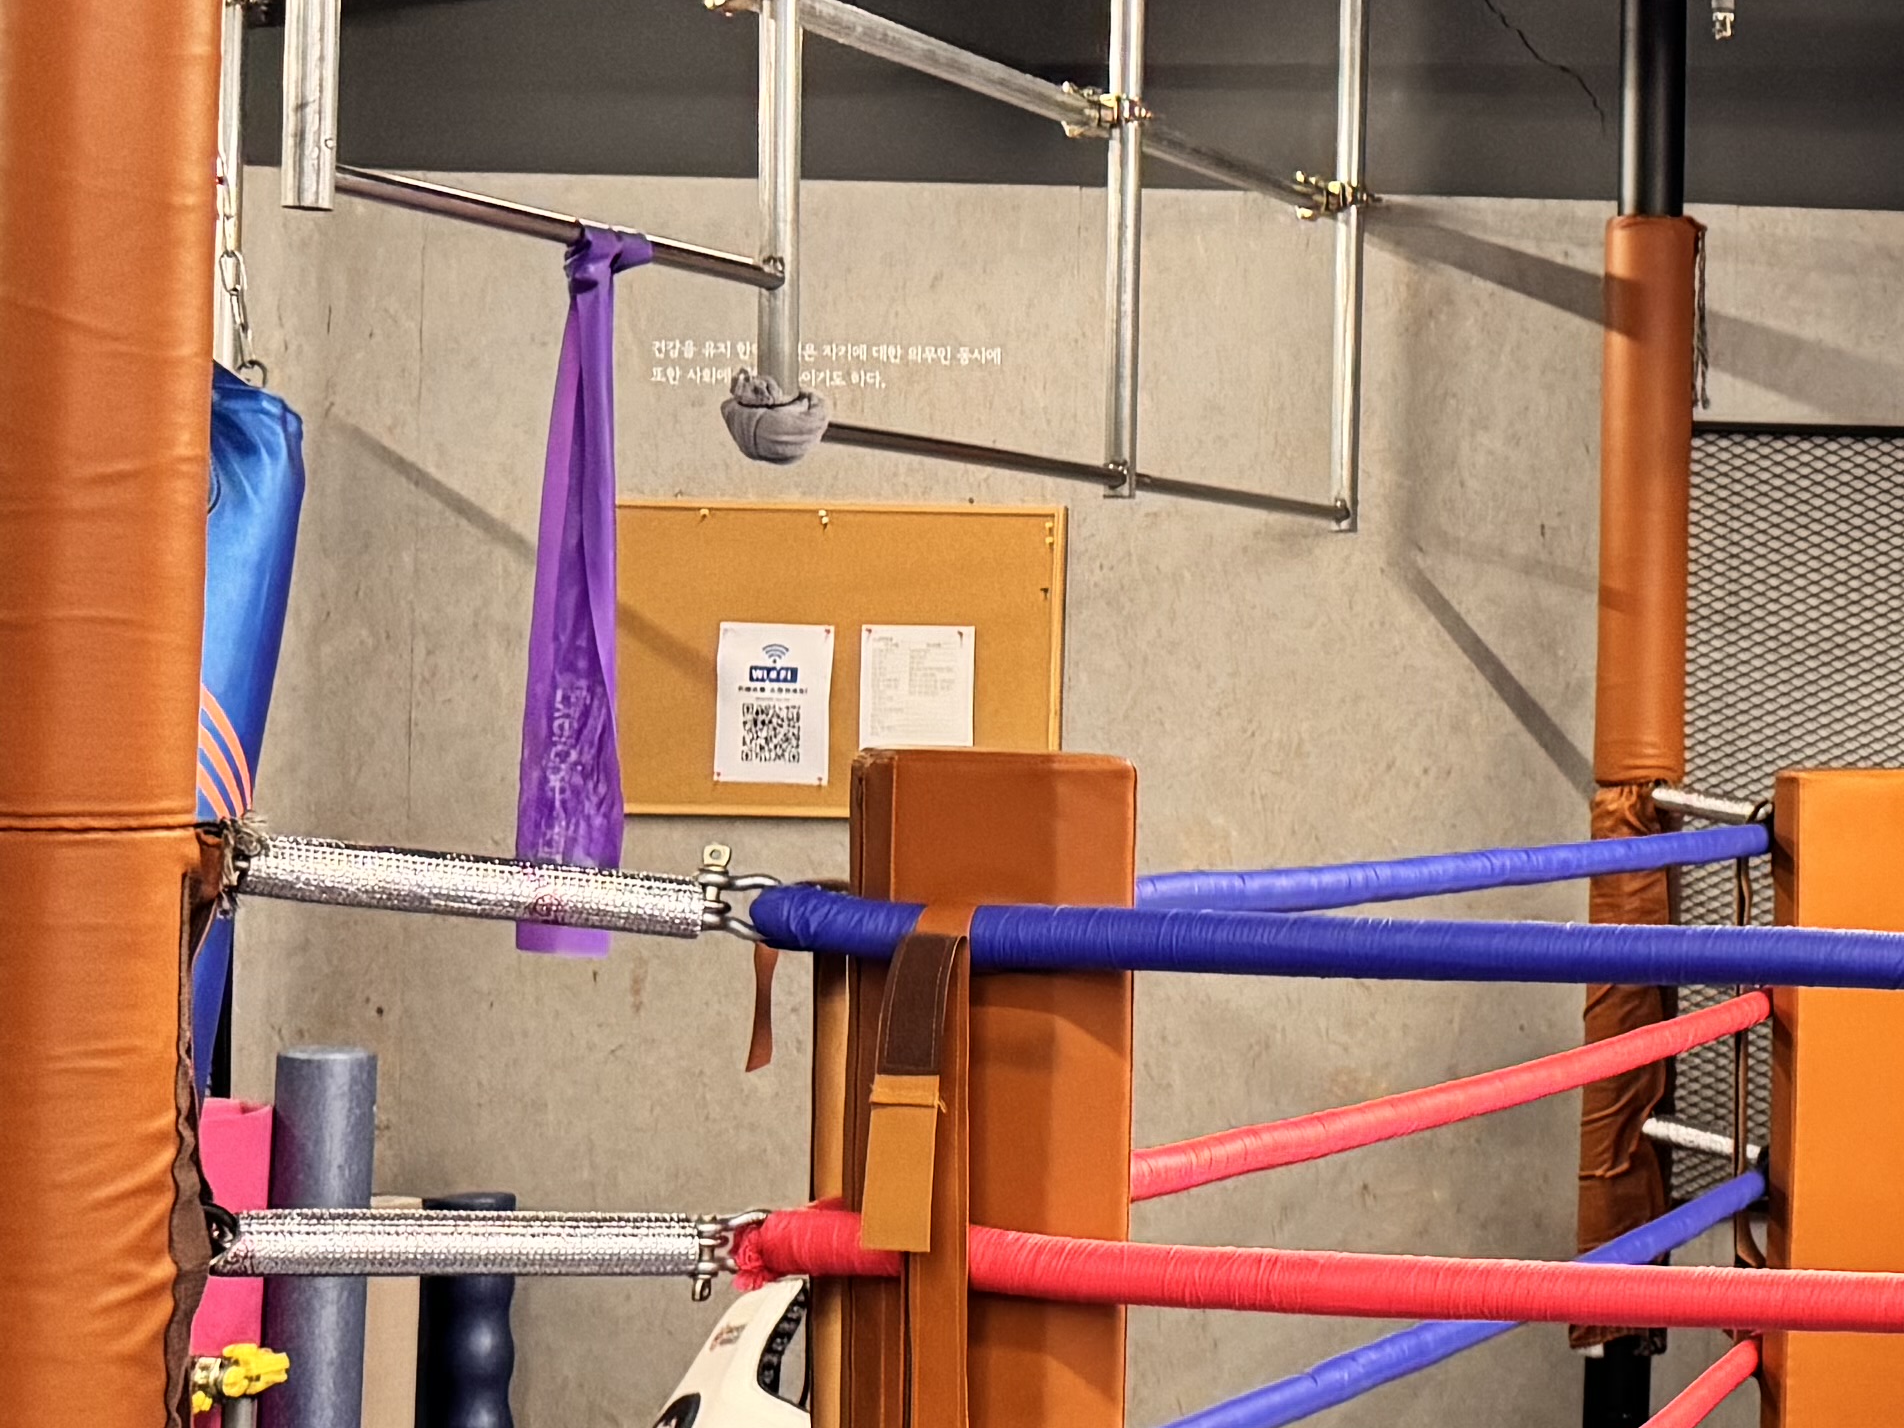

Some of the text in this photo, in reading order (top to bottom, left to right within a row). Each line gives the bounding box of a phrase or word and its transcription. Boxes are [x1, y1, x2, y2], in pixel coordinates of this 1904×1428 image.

[651, 339, 697, 360] 건강을
[702, 340, 731, 359] 유지
[798, 340, 818, 362] 은
[822, 342, 867, 362] 자기에
[872, 343, 901, 365] 대한
[650, 365, 681, 385] 또한
[687, 365, 732, 386] 사회에
